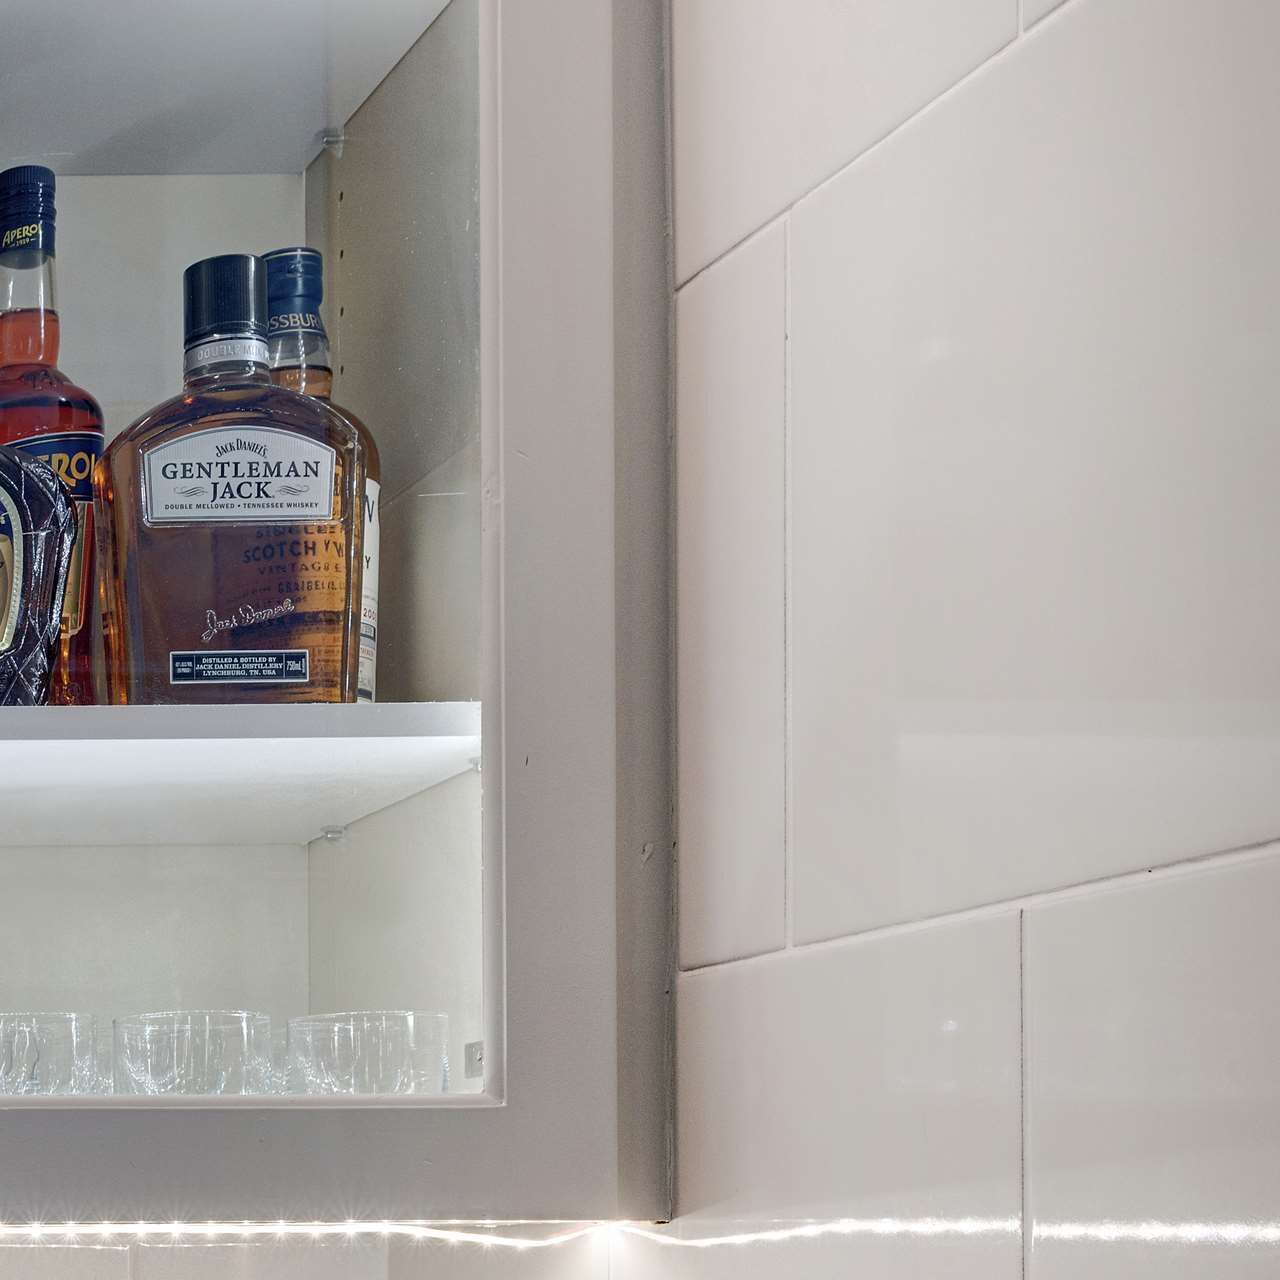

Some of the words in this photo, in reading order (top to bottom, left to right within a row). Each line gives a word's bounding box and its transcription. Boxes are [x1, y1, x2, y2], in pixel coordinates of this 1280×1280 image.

[15, 237, 30, 247] 1919
[215, 441, 236, 458] JACK
[236, 438, 268, 459] DANIEL'S
[161, 460, 321, 480] GENTLEMAN
[210, 481, 272, 502] JACK
[164, 502, 193, 510] DOUBLE
[196, 502, 235, 510] MELLOWED
